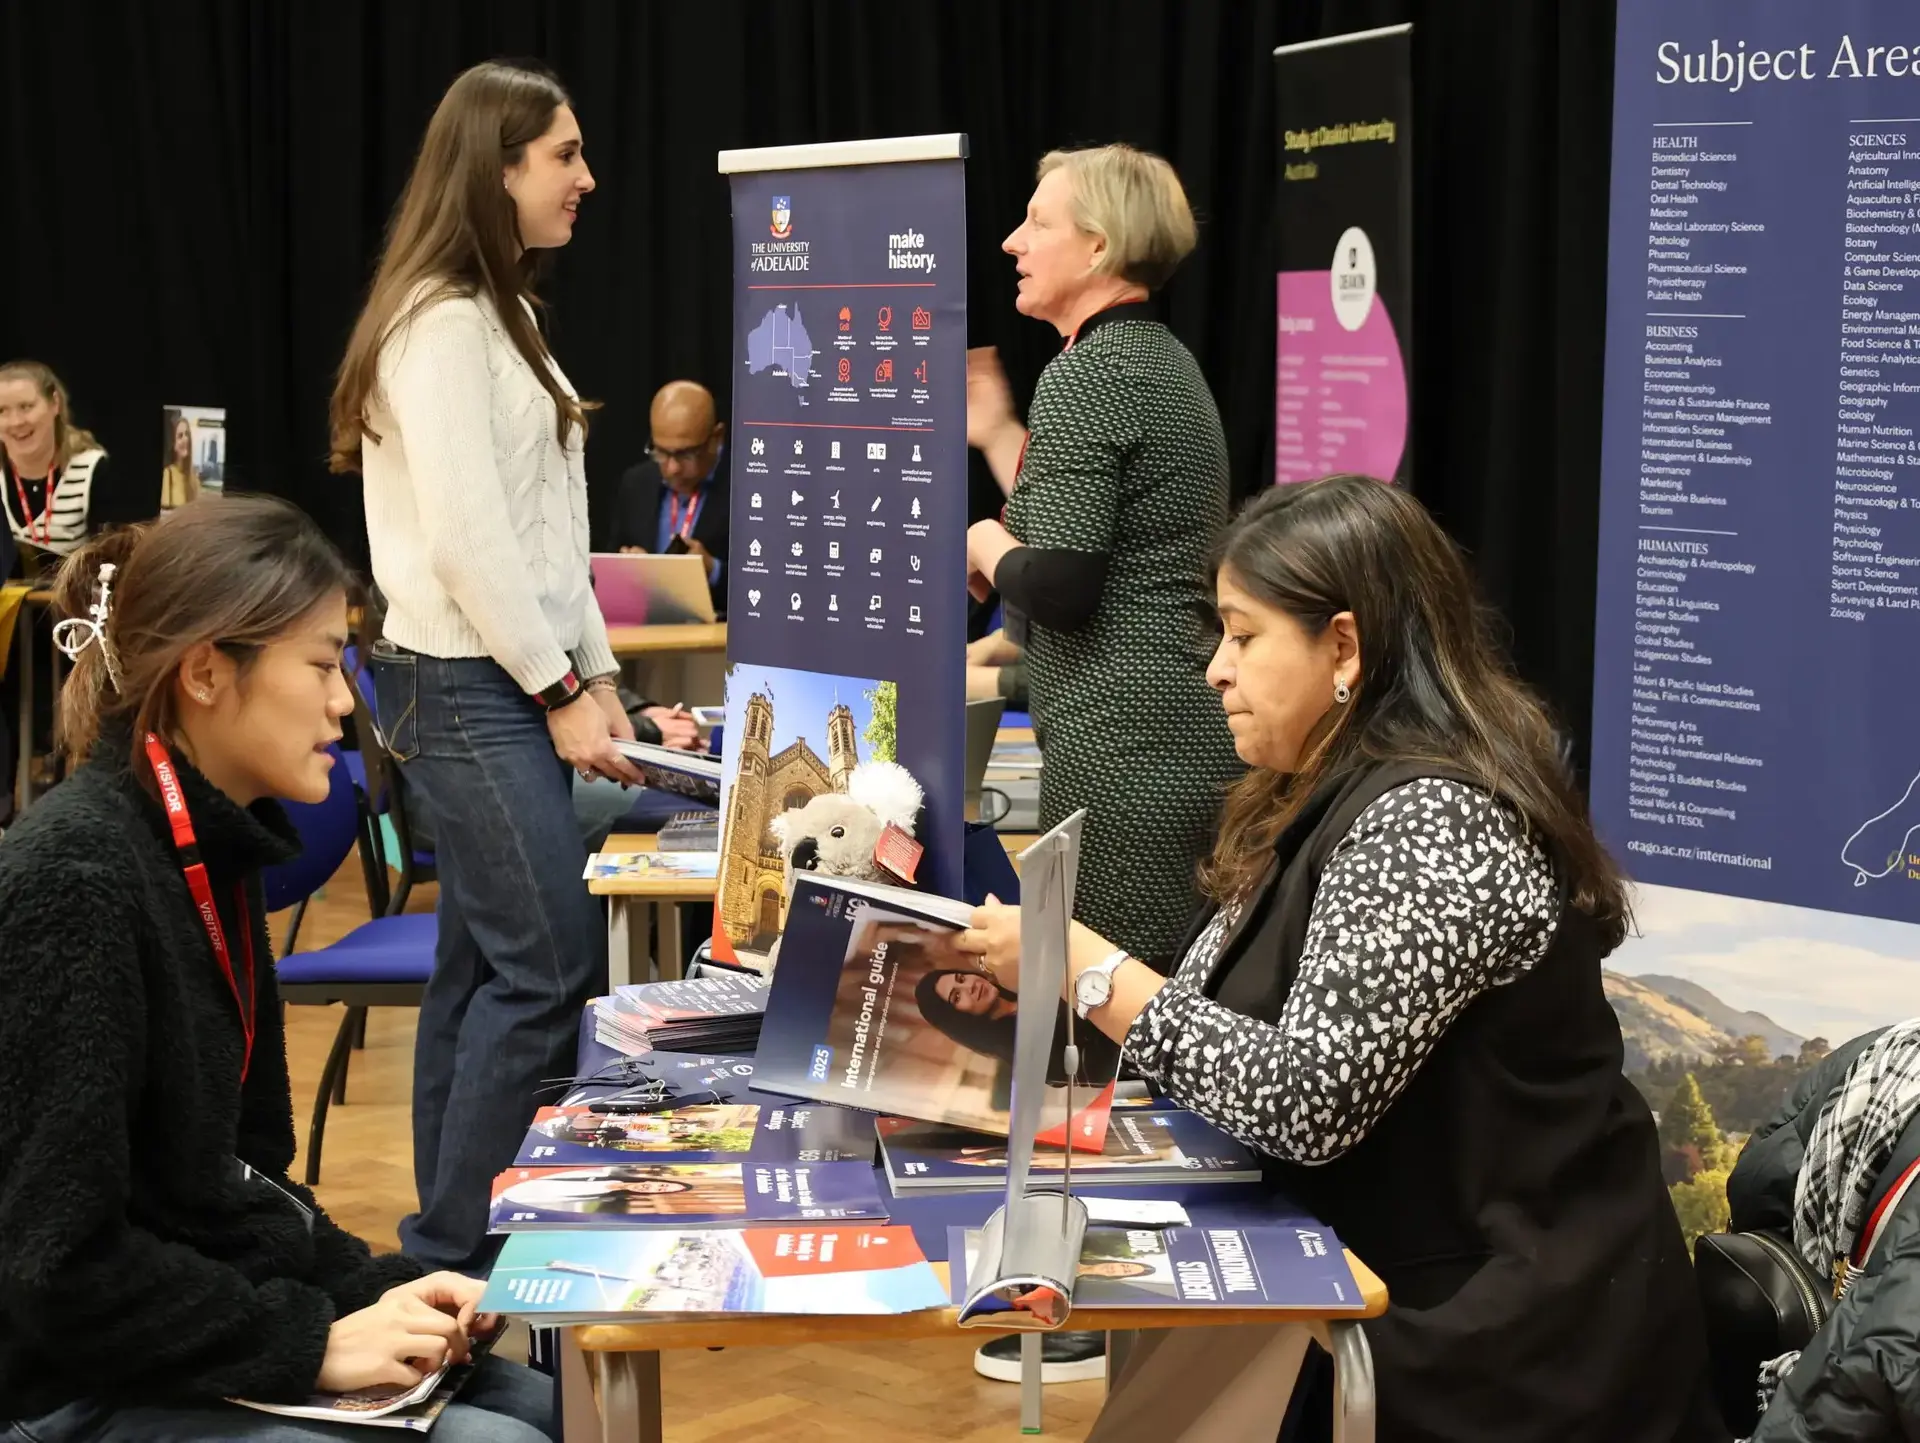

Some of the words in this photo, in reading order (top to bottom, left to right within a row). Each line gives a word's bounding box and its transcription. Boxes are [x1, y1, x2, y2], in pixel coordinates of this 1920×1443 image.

[1656, 39, 1816, 92] Subject
[1653, 136, 1698, 148] HEALTH
[1849, 134, 1907, 147] SCIENCES
[1652, 152, 1698, 162] Biomedical
[1700, 152, 1737, 162] Sciences
[1848, 150, 1901, 163] Agricultural
[1652, 166, 1690, 178] Dentistry
[1847, 165, 1889, 177] Anatomy
[1651, 180, 1679, 190] Dental
[1680, 180, 1728, 191] Technology
[1847, 179, 1885, 190] Artificial
[1650, 194, 1669, 204] Oral
[1670, 194, 1699, 203] Health
[1846, 194, 1902, 206] Aquaculture
[1903, 193, 1911, 204] &
[1650, 208, 1688, 218] Medicine
[1846, 208, 1906, 220] Biochemistry
[1907, 208, 1915, 219] &
[1649, 221, 1682, 232] Medical
[1684, 222, 1730, 233] Laboratory
[1731, 221, 1765, 232] Science
[1845, 222, 1910, 235] Biotechnology
[888, 228, 925, 249] make
[1649, 235, 1690, 247] Pathology
[1845, 237, 1877, 249] Botany
[752, 243, 766, 254] THE
[767, 241, 810, 253] UNIVERSITY
[1648, 249, 1690, 260] Pharmacy
[1844, 252, 1891, 263] Computer
[757, 256, 810, 272] ADELAIDE
[888, 249, 937, 274] history.
[1648, 263, 1712, 273] Pharmaceutical
[1714, 263, 1747, 274] Science
[1844, 266, 1852, 277] &
[1853, 266, 1881, 277] Game
[1647, 276, 1707, 289] Physiotherapy
[1843, 280, 1866, 291] Data
[1867, 281, 1903, 292] Science
[1647, 290, 1673, 300] Public
[1674, 290, 1702, 301] Health
[1843, 295, 1879, 307] Ecology
[1842, 309, 1873, 322] Energy
[1646, 325, 1698, 338] BUSINESS
[1841, 323, 1907, 335] Environmental
[1645, 341, 1693, 353] Accounting
[1841, 338, 1864, 348] Food
[1866, 338, 1902, 349] Science
[1903, 339, 1911, 350] &
[1645, 355, 1682, 365] Business
[1684, 356, 1722, 367] Analytics
[1840, 352, 1879, 363] Forensic
[1644, 368, 1690, 379] Economics
[1840, 366, 1880, 378] Genetics
[1644, 382, 1716, 395] Entrepreneurship
[1839, 380, 1891, 394] Geographic
[1643, 395, 1676, 406] Finance
[1678, 396, 1685, 407] &
[1687, 397, 1735, 408] Sustainable
[1736, 399, 1771, 410] Finance
[1839, 395, 1888, 409] Geography
[1643, 409, 1673, 420] Human
[1675, 410, 1715, 421] Resource
[1716, 412, 1771, 426] Management
[1838, 409, 1875, 422] Geology
[1642, 423, 1690, 434] Information
[1692, 424, 1725, 436] Science
[1837, 424, 1870, 434] Human
[1872, 425, 1913, 436] Nutrition
[1642, 437, 1694, 448] International
[1696, 439, 1732, 450] Business
[1837, 438, 1869, 448] Marine
[1870, 439, 1907, 450] Science
[1908, 440, 1915, 451] &
[1641, 450, 1696, 463] Management
[1697, 452, 1705, 463] &
[1706, 453, 1752, 466] Leadership
[1836, 452, 1895, 464] Mathematics
[1897, 454, 1905, 465] &
[1641, 463, 1691, 475] Governance
[1836, 466, 1894, 480] Microbiology
[1640, 477, 1683, 490] Marketing
[1835, 480, 1897, 493] Neuroscience
[1640, 490, 1688, 503] Sustainable
[1690, 493, 1727, 505] Business
[1834, 494, 1899, 509] Pharmacology
[1900, 498, 1908, 508] &
[1639, 504, 1673, 515] Tourism
[1834, 508, 1868, 520] Physics
[1833, 522, 1881, 537] Physiology
[1638, 539, 1708, 554] HUMANITIES
[1833, 537, 1883, 551] Psychology
[1832, 551, 1873, 563] Software
[1637, 567, 1687, 582] Criminology
[1832, 565, 1862, 577] Sports
[1864, 567, 1900, 579] Science
[1637, 581, 1678, 593] Education
[1831, 579, 1857, 591] Sport
[1858, 581, 1918, 595] Development
[1636, 594, 1665, 607] English
[1667, 596, 1674, 607] &
[1676, 598, 1720, 611] Linguistics
[1831, 593, 1875, 608] Surveying
[1877, 596, 1884, 607] &
[1886, 598, 1909, 609] Land
[1635, 608, 1666, 619] Gender
[1668, 610, 1699, 623] Studies
[1830, 607, 1866, 621] Zoology
[1635, 622, 1680, 636] Geography
[1633, 661, 1651, 673] Law
[1632, 702, 1657, 713] Music
[1679, 720, 1697, 732] Arts
[156, 761, 182, 814] VISITOR
[1629, 782, 1670, 797] Sociology
[1666, 813, 1674, 824] &
[1675, 814, 1704, 828] TESOL
[1627, 840, 1772, 870] otago.ac.nz/international
[199, 900, 221, 951] VISITOR
[878, 996, 891, 1037] postgraduate
[887, 961, 899, 996] coursework
[841, 986, 878, 1090] International
[869, 941, 889, 985] guide
[812, 1048, 830, 1081] 2025
[764, 1110, 787, 1131] rankings
[788, 1110, 811, 1129] Subject
[1126, 1230, 1161, 1254] GUIDE
[1208, 1229, 1258, 1293] INTERNATIONAL
[1175, 1260, 1217, 1301] STUDENT
